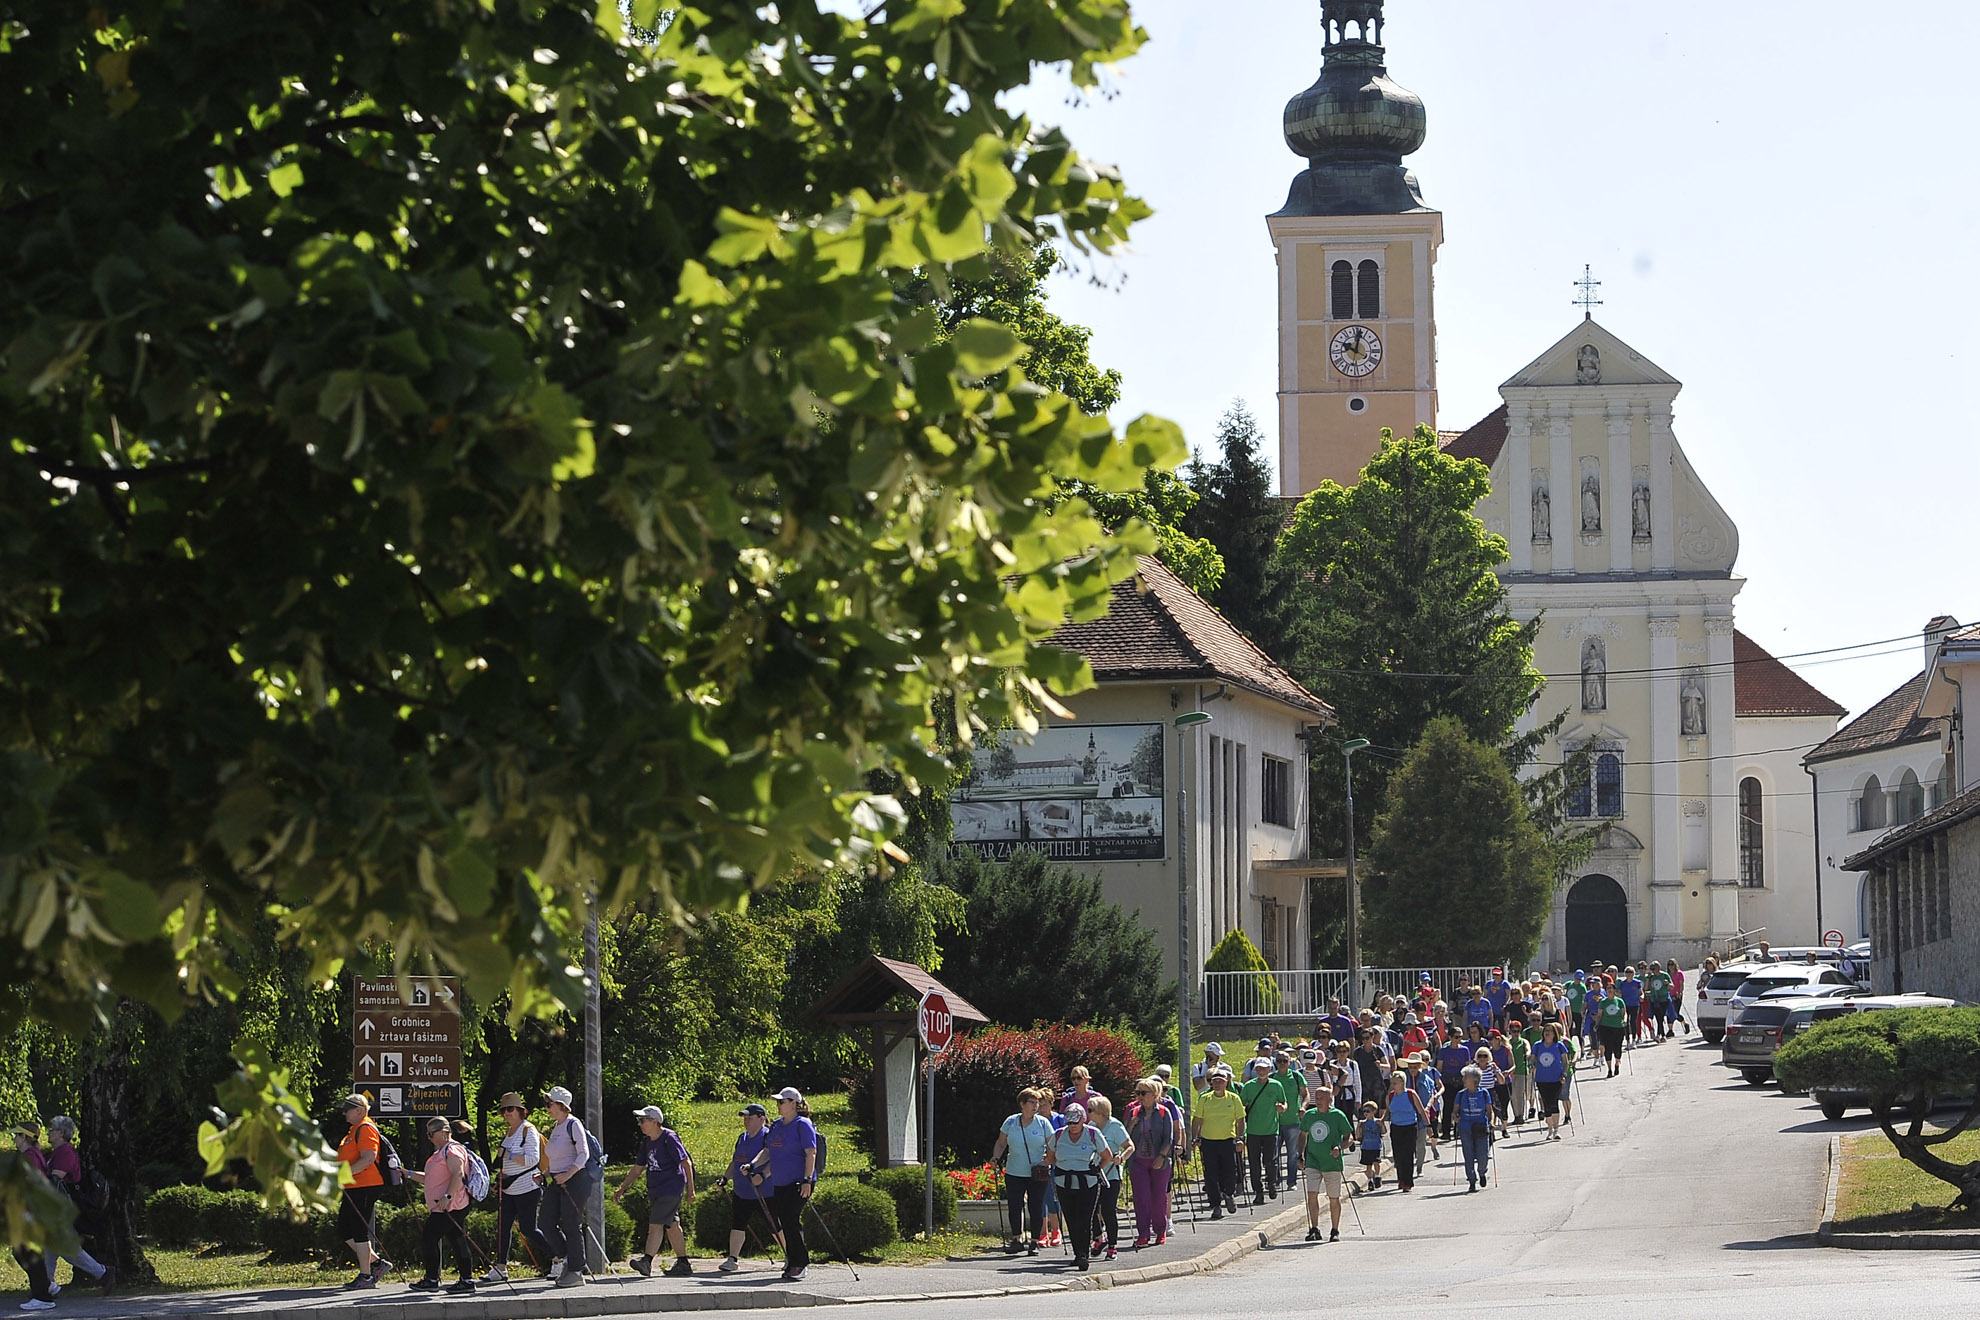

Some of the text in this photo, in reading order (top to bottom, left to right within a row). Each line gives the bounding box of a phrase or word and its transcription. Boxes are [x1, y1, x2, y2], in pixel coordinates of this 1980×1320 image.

[998, 842, 1013, 858] ZA
[360, 982, 398, 992] Pavlinski
[359, 996, 400, 1005] samostan
[391, 1016, 431, 1027] Grobnica
[922, 1007, 950, 1034] STOP
[412, 1031, 448, 1042] fašizma
[412, 1053, 444, 1065] Kapela
[408, 1067, 449, 1076] Sv.Ivana
[413, 1101, 448, 1111] kolodvor
